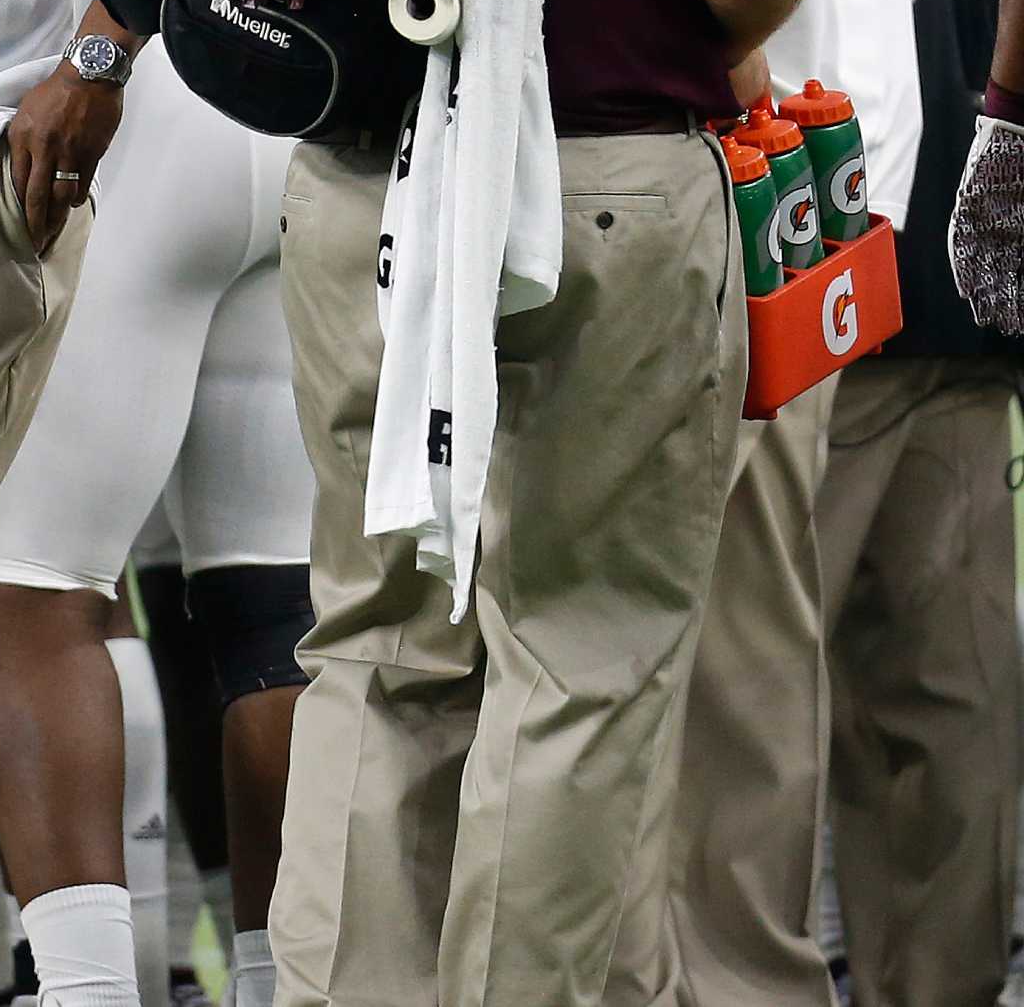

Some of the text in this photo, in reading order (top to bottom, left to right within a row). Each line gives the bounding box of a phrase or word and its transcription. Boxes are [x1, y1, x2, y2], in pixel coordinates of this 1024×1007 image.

[777, 183, 817, 245] G
[830, 153, 865, 215] G
[822, 268, 858, 356] G
